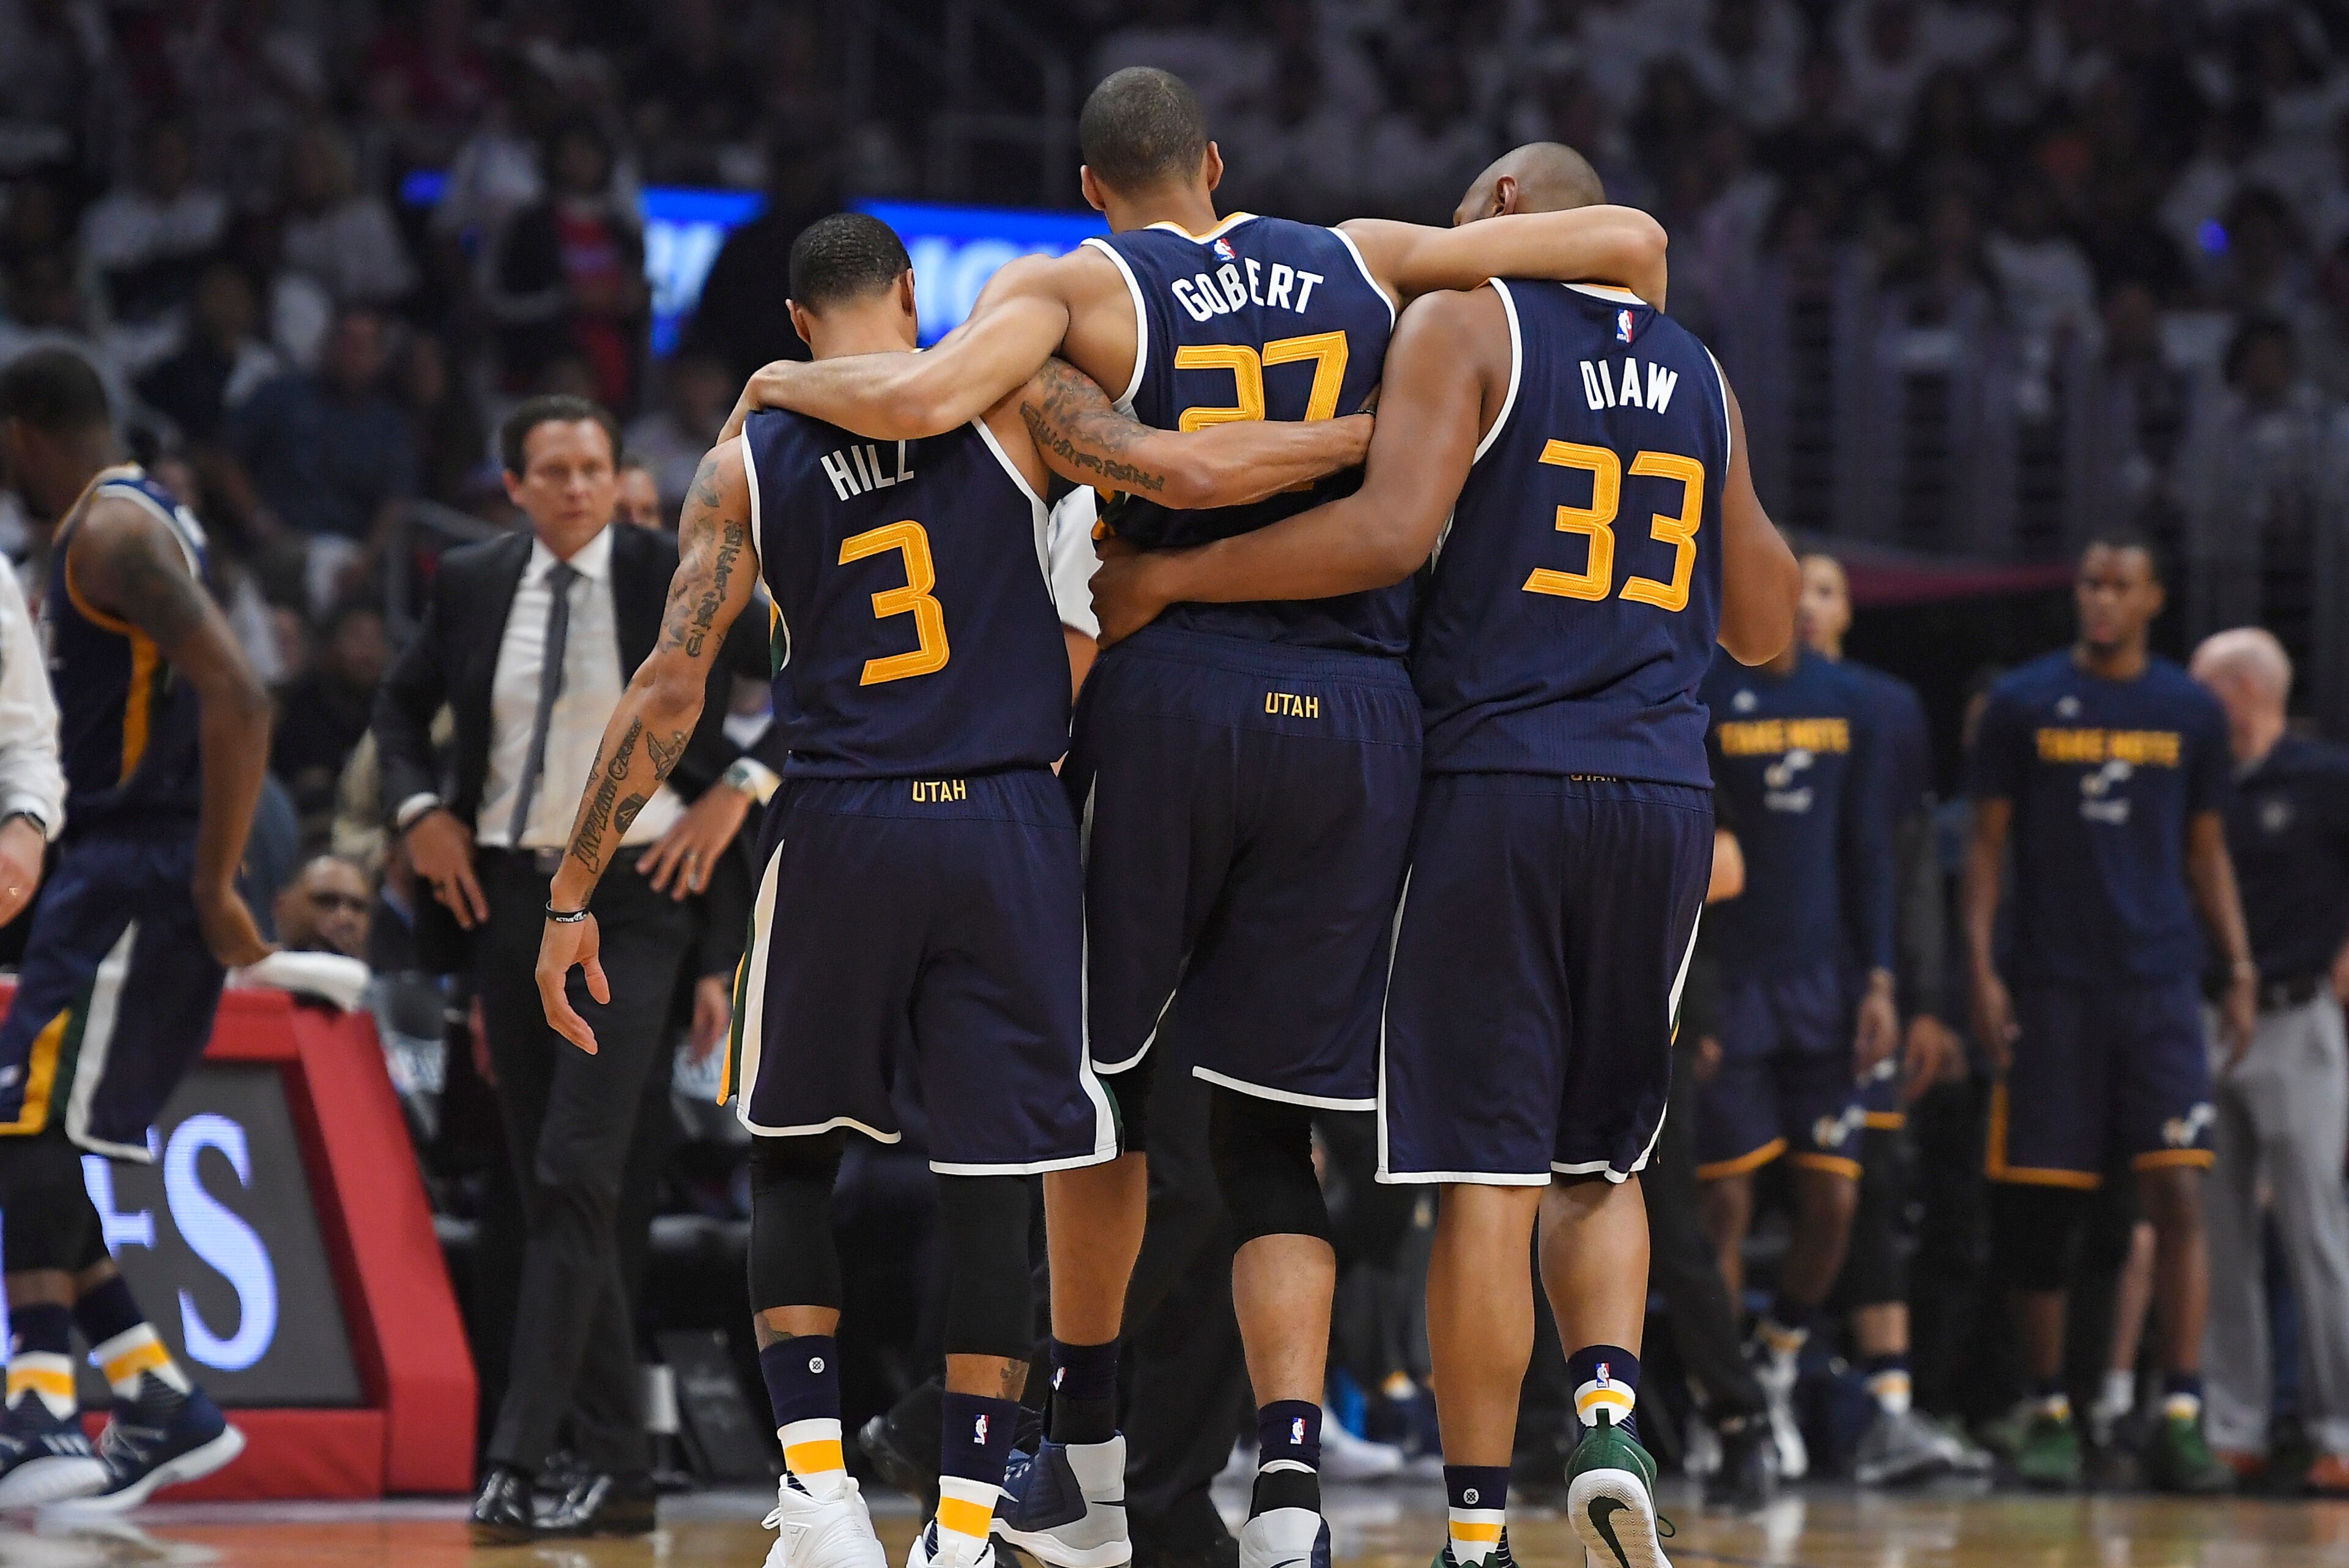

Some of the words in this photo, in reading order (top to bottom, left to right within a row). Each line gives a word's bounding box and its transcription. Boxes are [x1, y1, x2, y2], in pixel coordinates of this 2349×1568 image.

[1171, 257, 1324, 322] GOBERT
[1174, 330, 1349, 434] 27
[1579, 357, 1679, 415] DIAW
[820, 439, 915, 502] HILL
[1521, 438, 1705, 612] 33
[837, 519, 950, 686] 3
[1264, 691, 1319, 719] UTAH
[1715, 719, 1783, 757] TAKE
[1785, 718, 1850, 754] NOTE
[2037, 728, 2104, 762] TAKE
[2108, 730, 2179, 767] NOTE
[912, 779, 967, 803] UTAH
